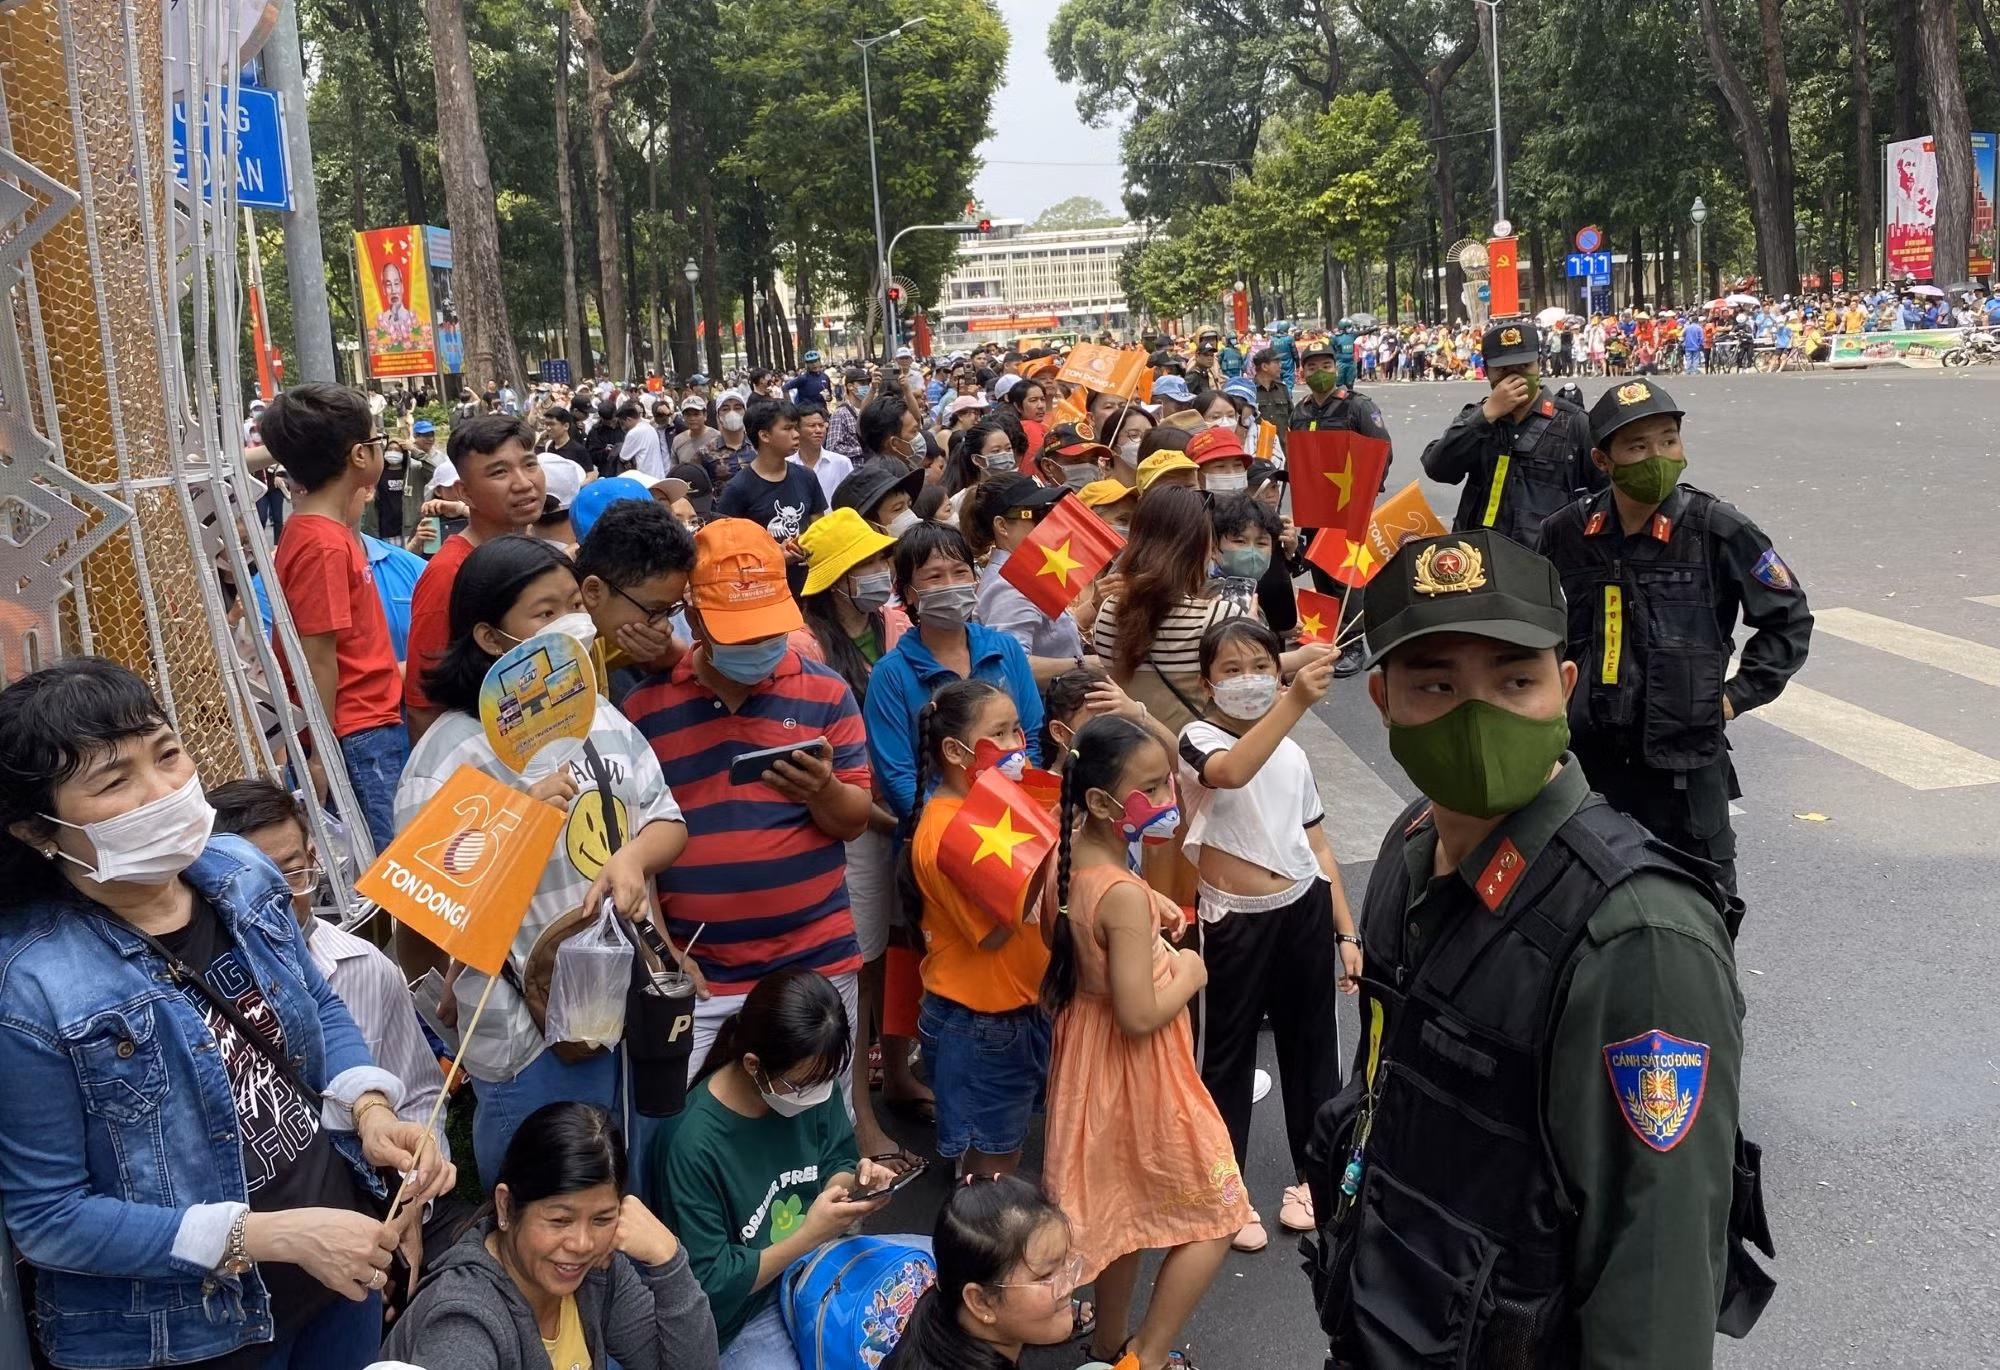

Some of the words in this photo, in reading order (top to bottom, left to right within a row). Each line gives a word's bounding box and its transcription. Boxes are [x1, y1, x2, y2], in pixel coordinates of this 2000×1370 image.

[1368, 521, 1385, 547] TON
[1607, 595, 1617, 672] POLICE
[414, 794, 522, 887] 25
[381, 859, 422, 897] TON
[415, 883, 467, 928] DONG
[668, 1014, 695, 1042] P
[1641, 1053, 1660, 1068] SÁT
